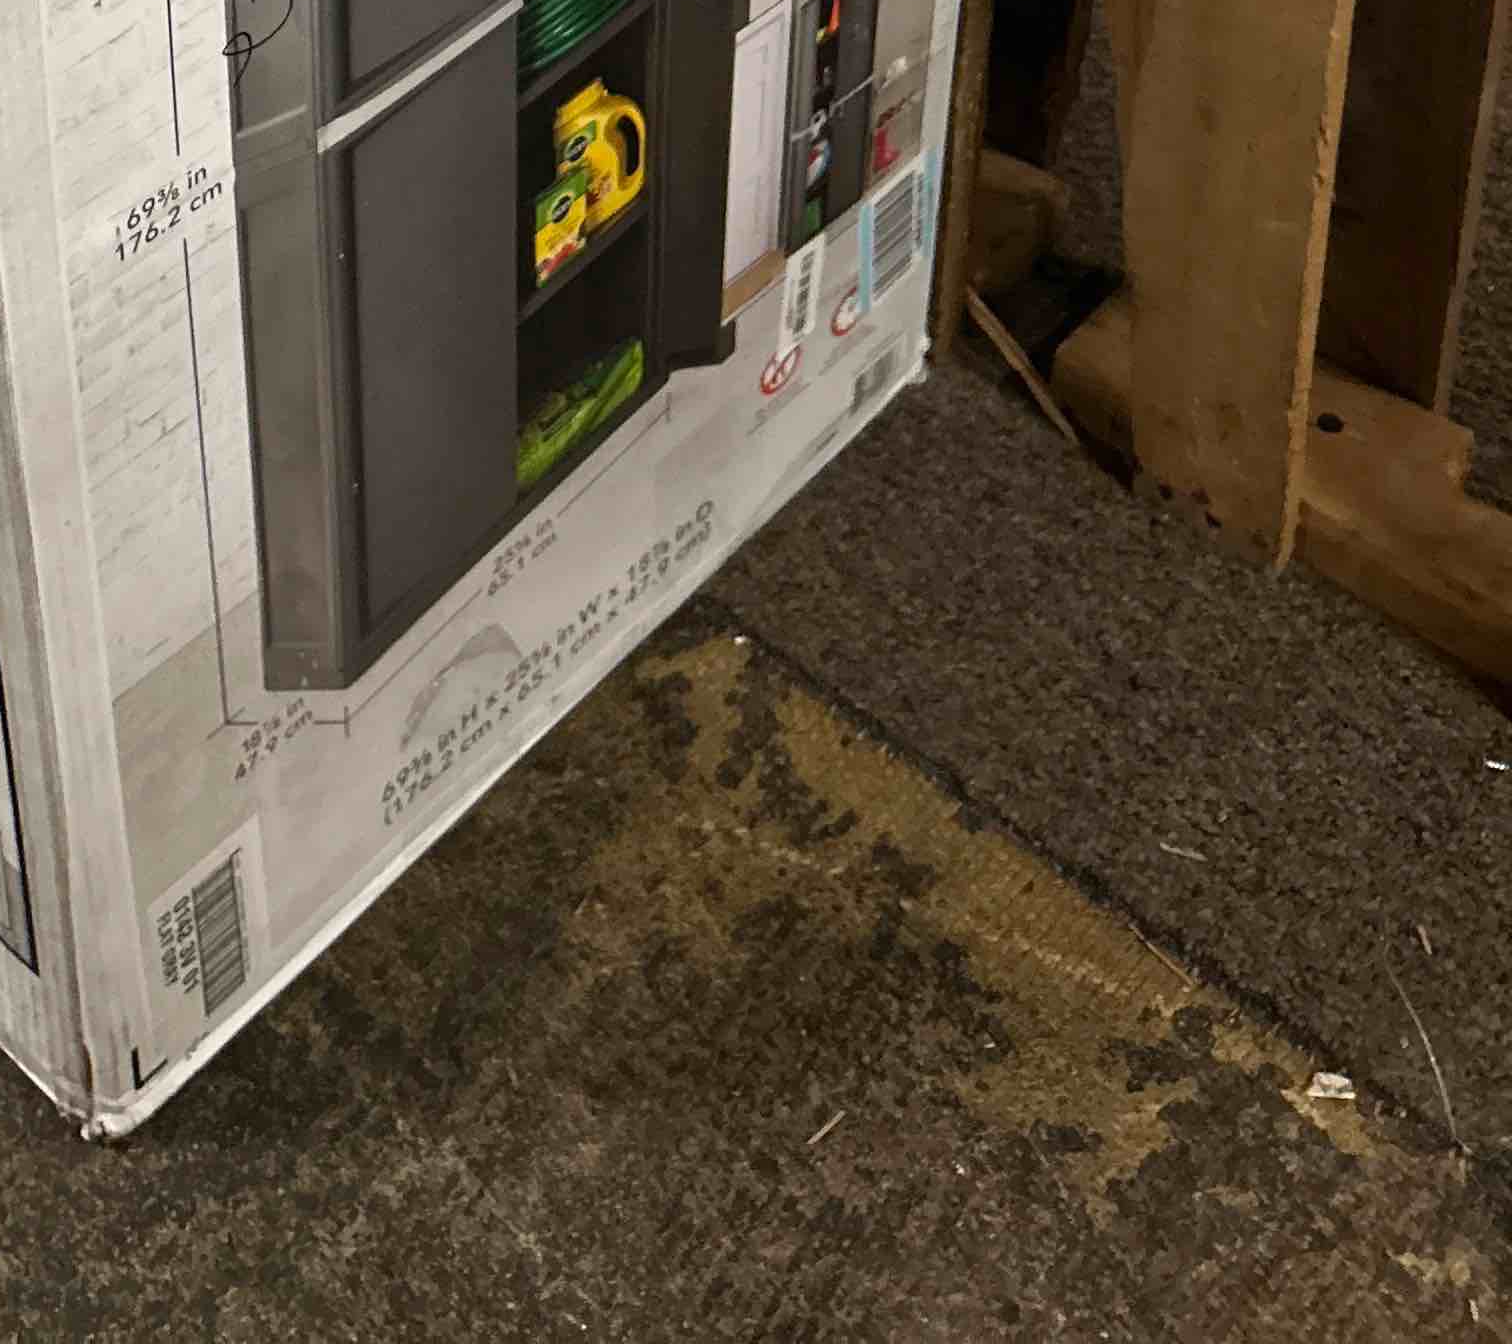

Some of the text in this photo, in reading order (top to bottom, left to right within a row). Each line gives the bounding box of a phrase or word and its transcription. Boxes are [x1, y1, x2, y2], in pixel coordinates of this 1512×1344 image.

[187, 167, 207, 190] in
[114, 181, 223, 262] 176.2 cm
